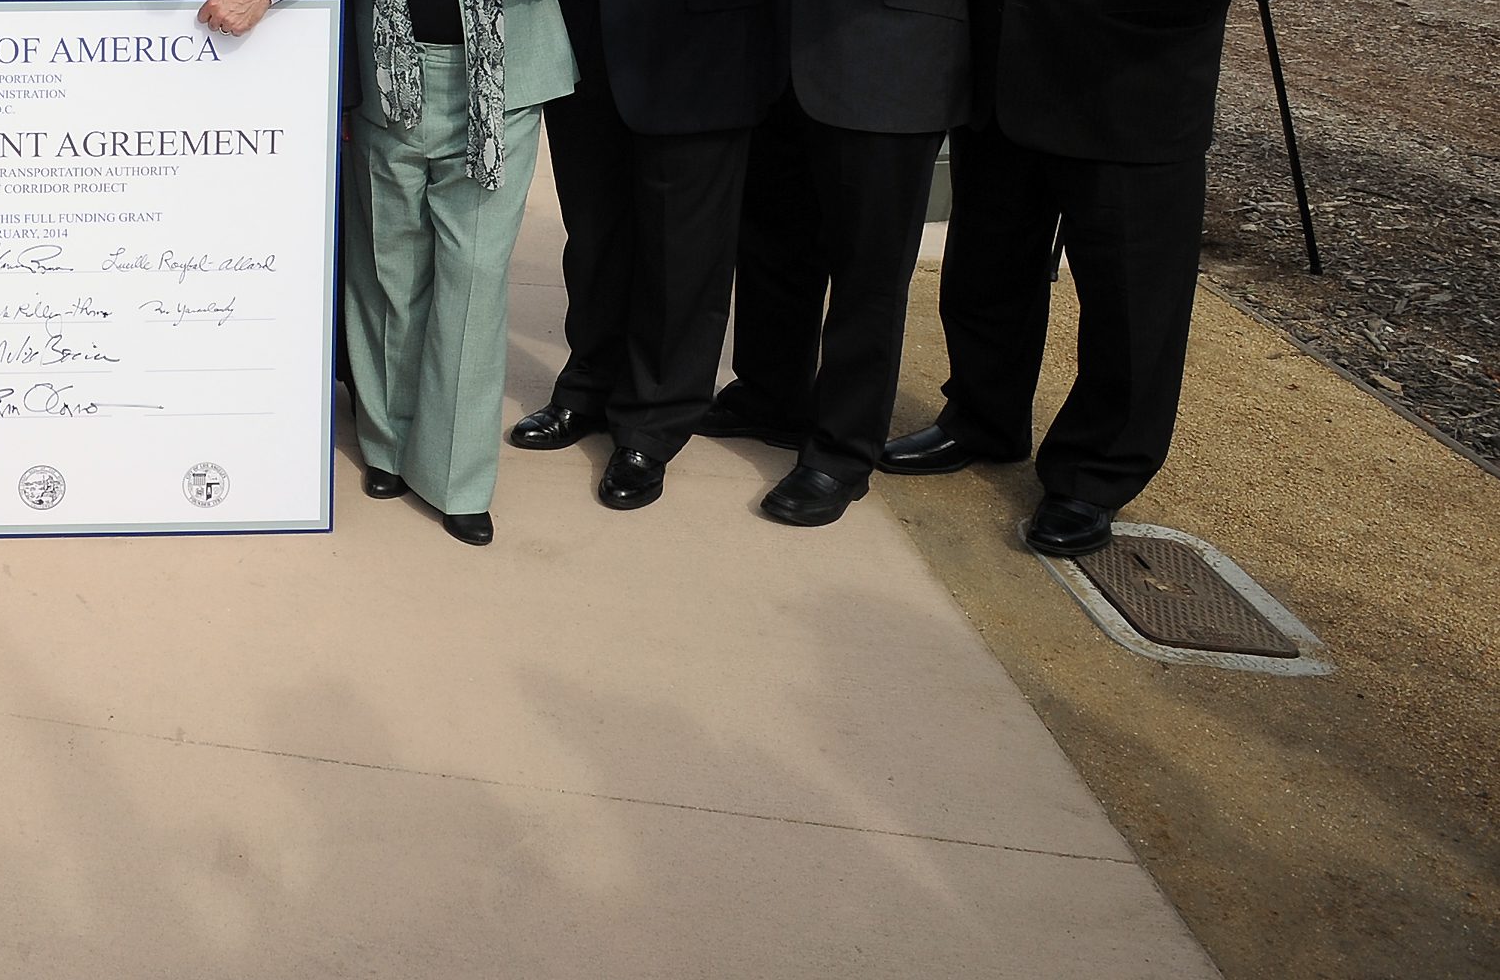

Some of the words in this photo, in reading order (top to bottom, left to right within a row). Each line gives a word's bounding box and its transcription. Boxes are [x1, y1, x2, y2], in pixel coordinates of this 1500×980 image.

[49, 35, 222, 64] AMERICA
[54, 129, 285, 158] AGREEMENT
[104, 165, 180, 177] AUTHORITY
[3, 183, 71, 194] CORRIDOR
[73, 182, 128, 194] PROJECT
[24, 213, 56, 224] FULL
[58, 212, 116, 224] FUNDING
[118, 212, 163, 223] GRANT
[43, 228, 69, 239] 2014
